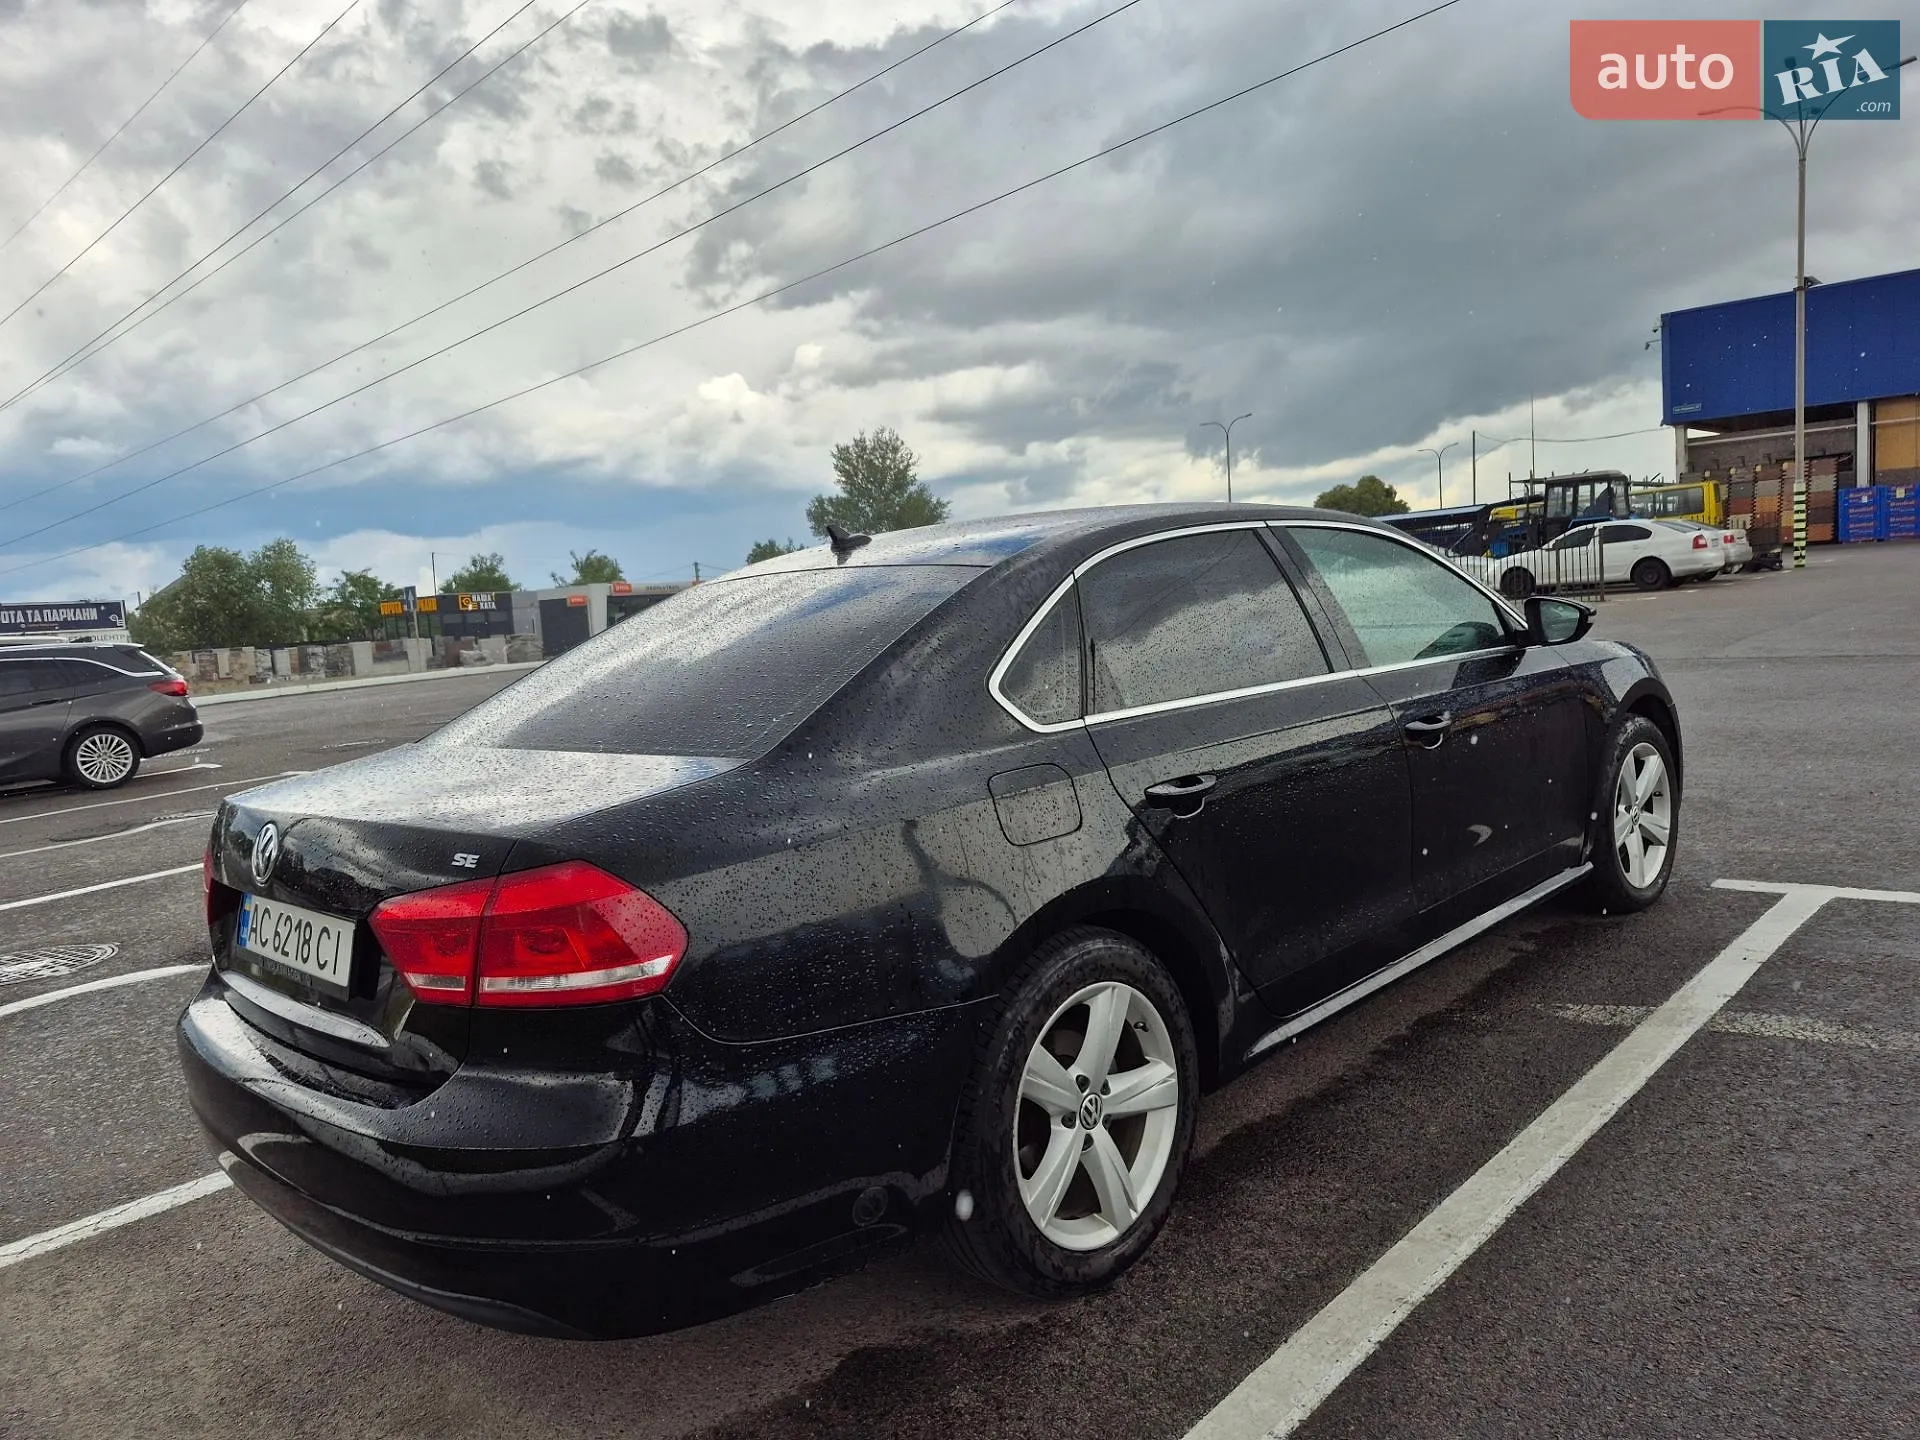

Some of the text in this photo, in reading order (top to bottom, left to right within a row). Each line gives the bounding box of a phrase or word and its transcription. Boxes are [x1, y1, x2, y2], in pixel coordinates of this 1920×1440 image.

[26, 609, 42, 623] ТА
[43, 607, 98, 622] ПАРКАНИ
[451, 853, 480, 868] SE
[273, 912, 313, 965] 6218
